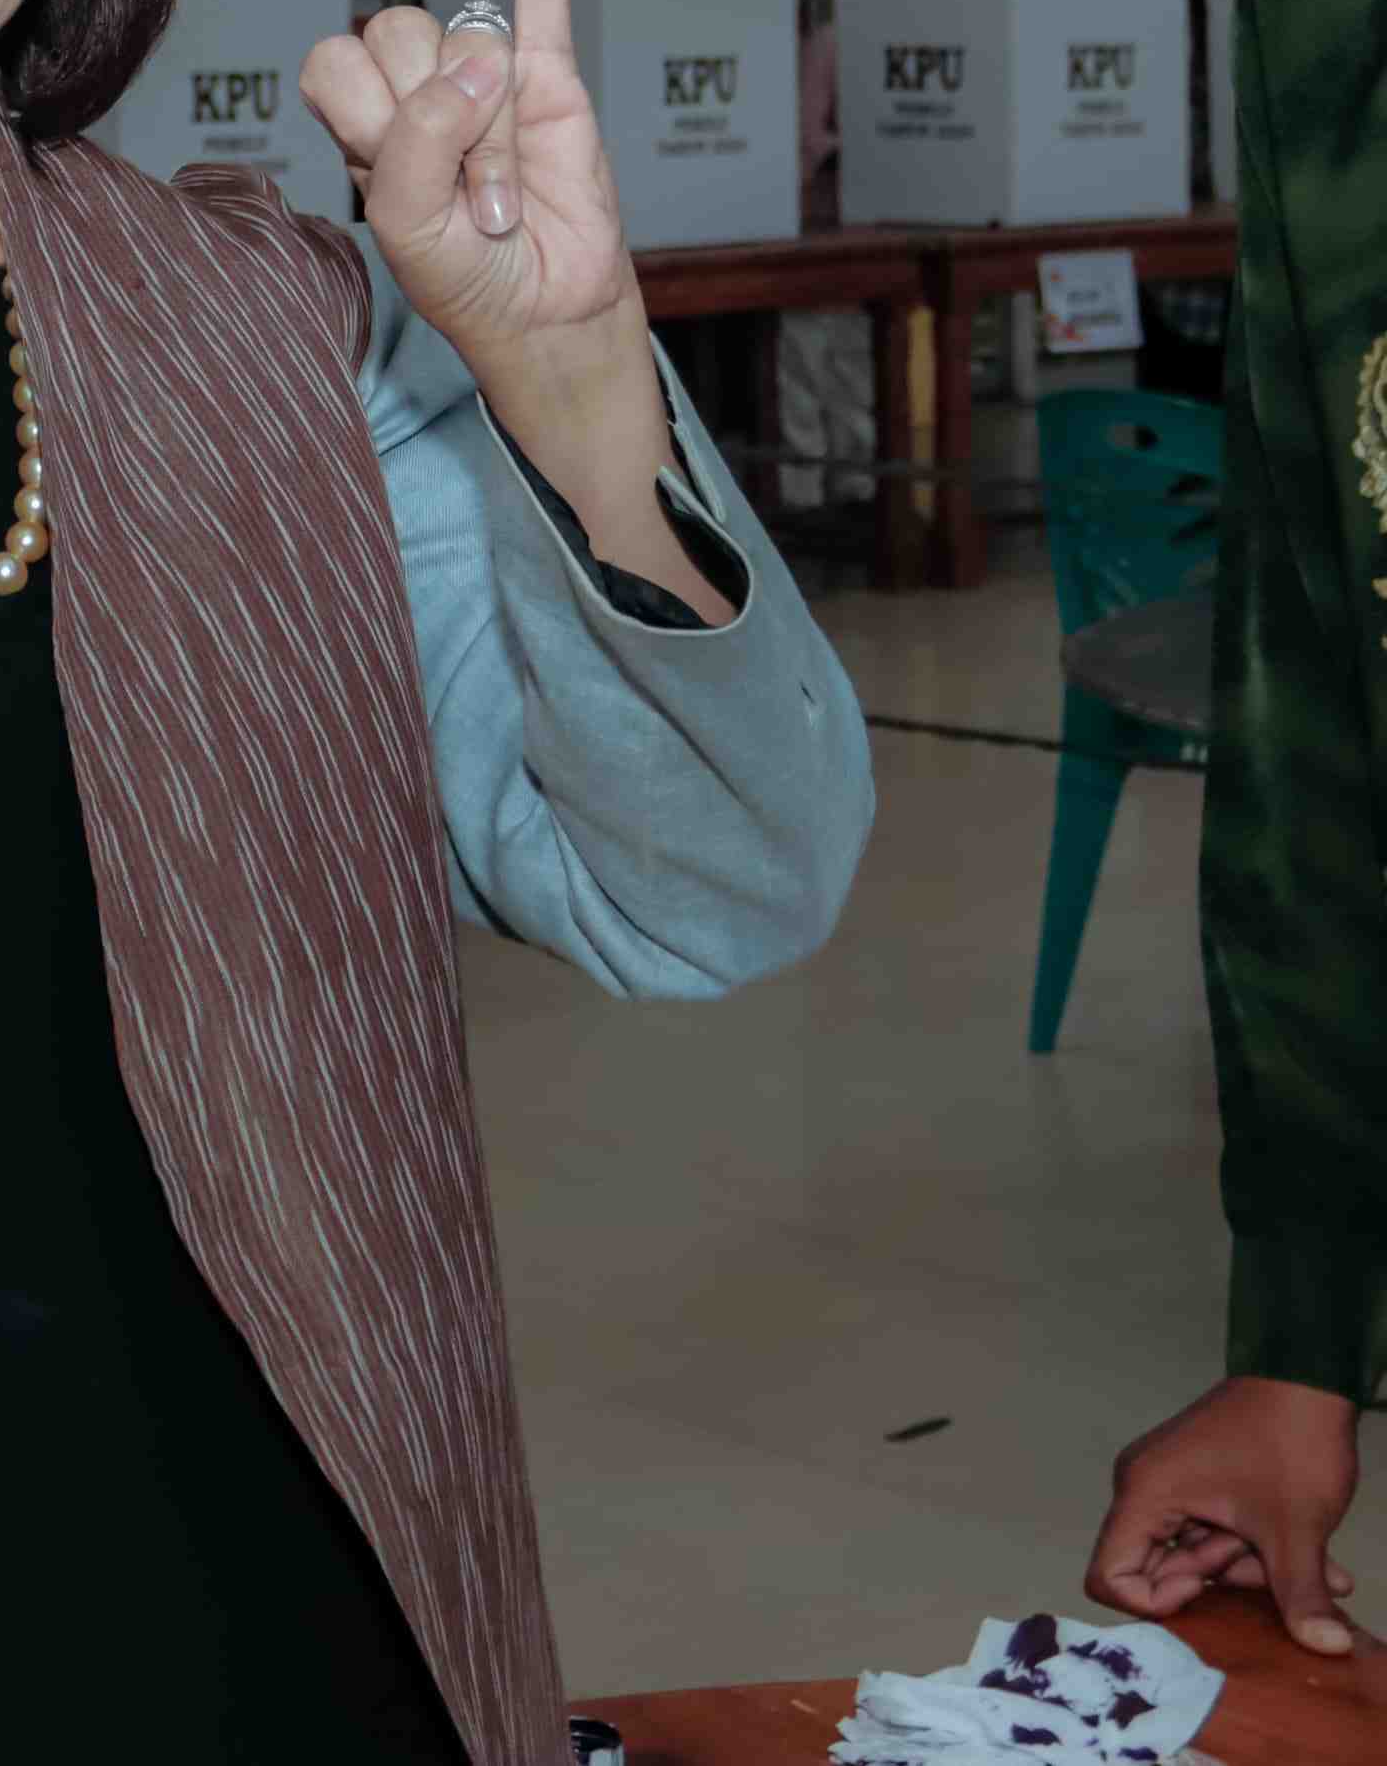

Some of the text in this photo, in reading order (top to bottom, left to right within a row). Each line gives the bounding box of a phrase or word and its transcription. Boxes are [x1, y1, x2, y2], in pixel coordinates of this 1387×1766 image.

[663, 55, 739, 105] KPU
[884, 44, 965, 92] KPU
[1066, 44, 1135, 90] KPU
[192, 71, 281, 124] KPU
